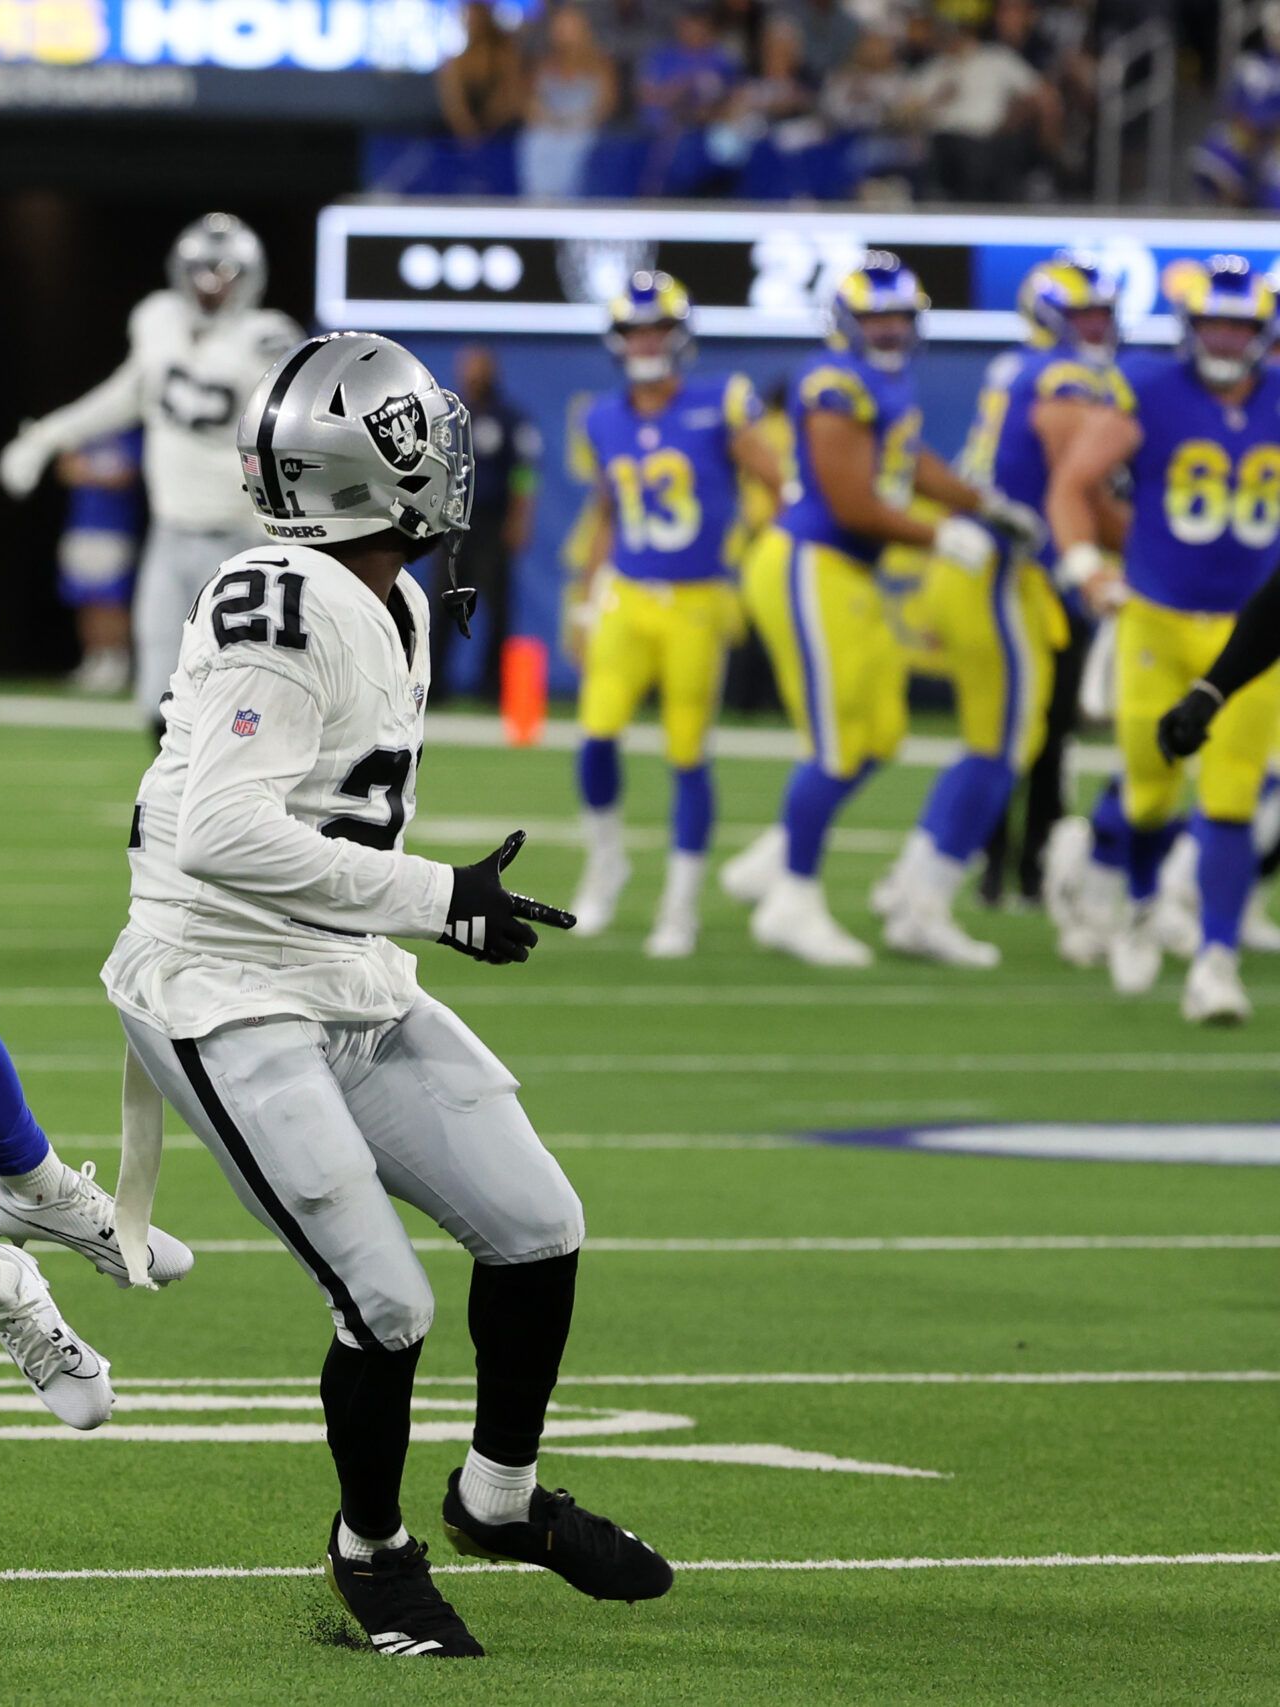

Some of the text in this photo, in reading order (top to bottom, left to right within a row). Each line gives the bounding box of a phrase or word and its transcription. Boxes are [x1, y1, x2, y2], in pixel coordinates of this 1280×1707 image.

[607, 447, 702, 553] 13
[263, 522, 327, 538] RAIDERS
[210, 567, 310, 650] 21
[233, 718, 257, 736] NFL
